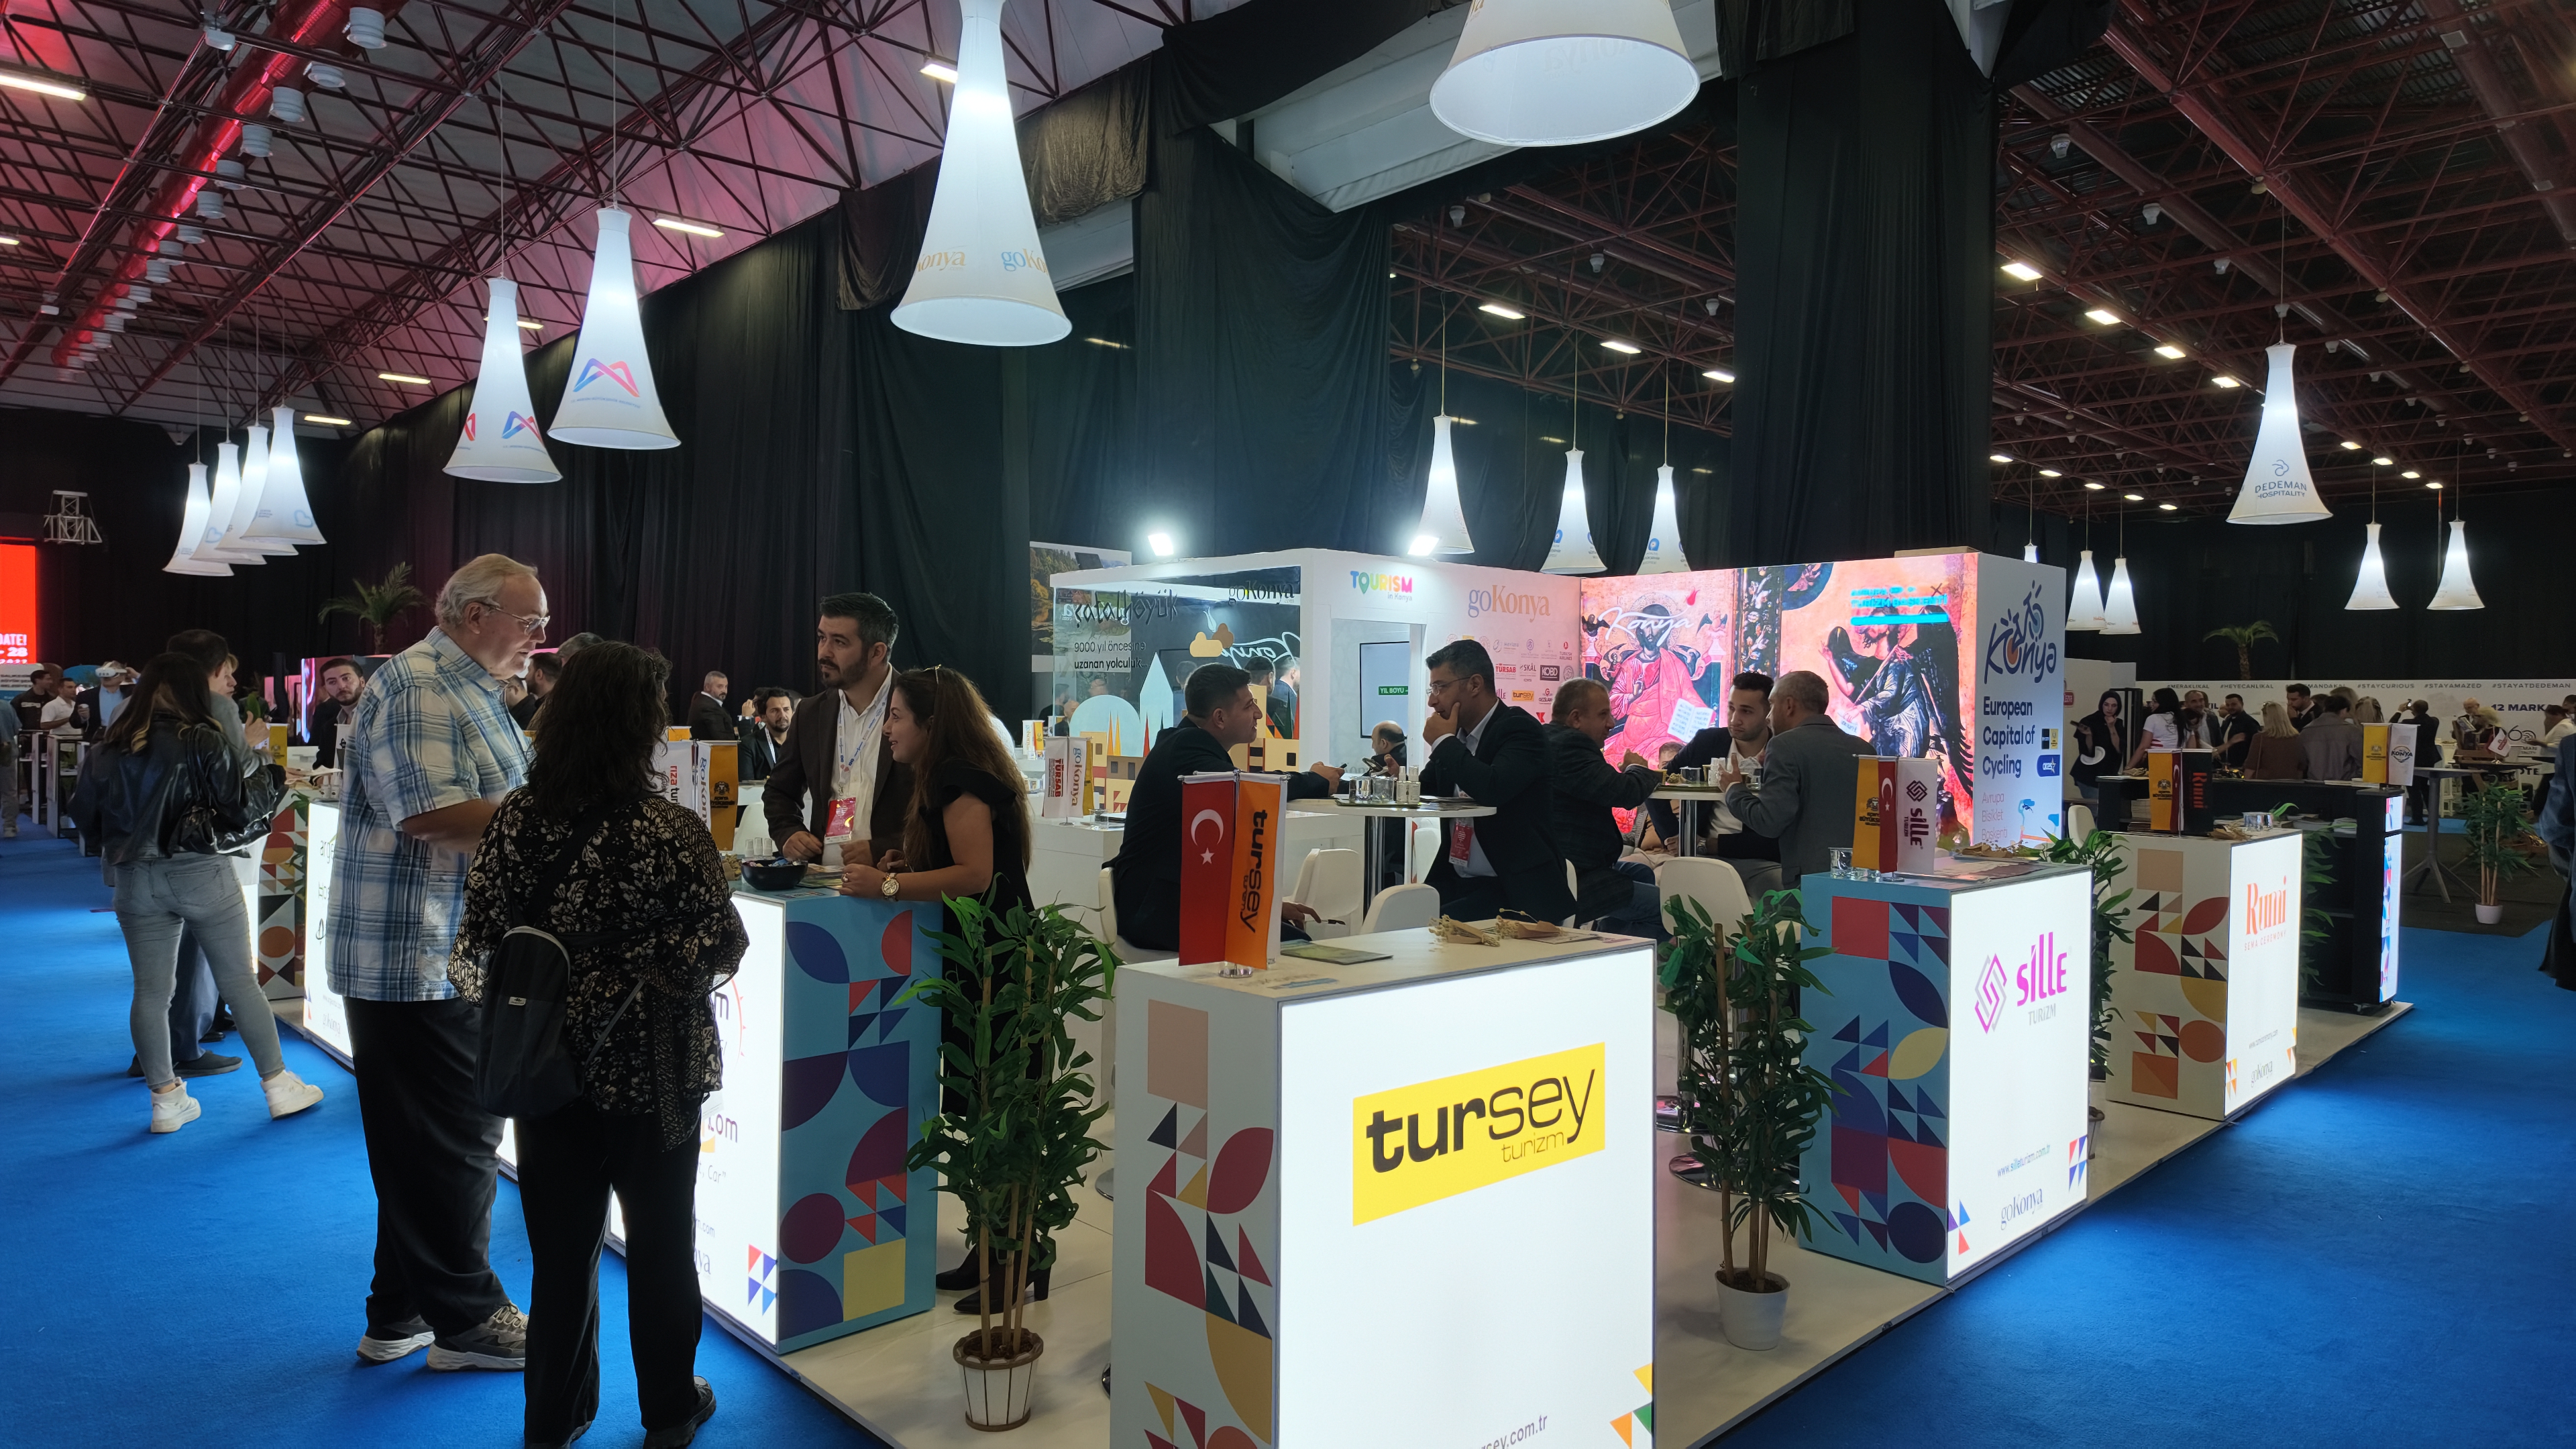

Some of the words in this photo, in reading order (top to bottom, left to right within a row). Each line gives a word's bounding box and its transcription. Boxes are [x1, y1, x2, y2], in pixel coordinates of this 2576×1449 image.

[2255, 480, 2307, 493] DEDEMAN
[2257, 490, 2305, 498] HOSPITALITY
[1350, 571, 1413, 594] TOURISM
[1395, 593, 1412, 601] Konya
[1468, 584, 1550, 623] goKonya
[1598, 606, 1694, 646] Konya
[7, 647, 28, 657] 28
[1074, 642, 1095, 653] 9000
[1097, 641, 1107, 654] yıl
[1108, 640, 1146, 652] öncesine
[1074, 660, 1105, 669] uzanan
[1983, 696, 2033, 722] European
[1983, 724, 2024, 749] Capital
[2025, 724, 2035, 745] of
[1055, 758, 1064, 798] TÜRSAB
[1071, 747, 1083, 806] goKonya
[1982, 755, 2022, 780] Cycling
[1982, 792, 2004, 806] Avrupa
[1982, 809, 2004, 822] Bisiklet
[1240, 809, 1268, 933] tursey
[2246, 875, 2287, 936] Rumi
[2244, 939, 2259, 951] SEMA
[2259, 930, 2287, 947] CEREMONY
[1366, 1069, 1596, 1173] tursey
[1501, 1131, 1564, 1163] turizm
[2000, 1188, 2043, 1231] goKonya
